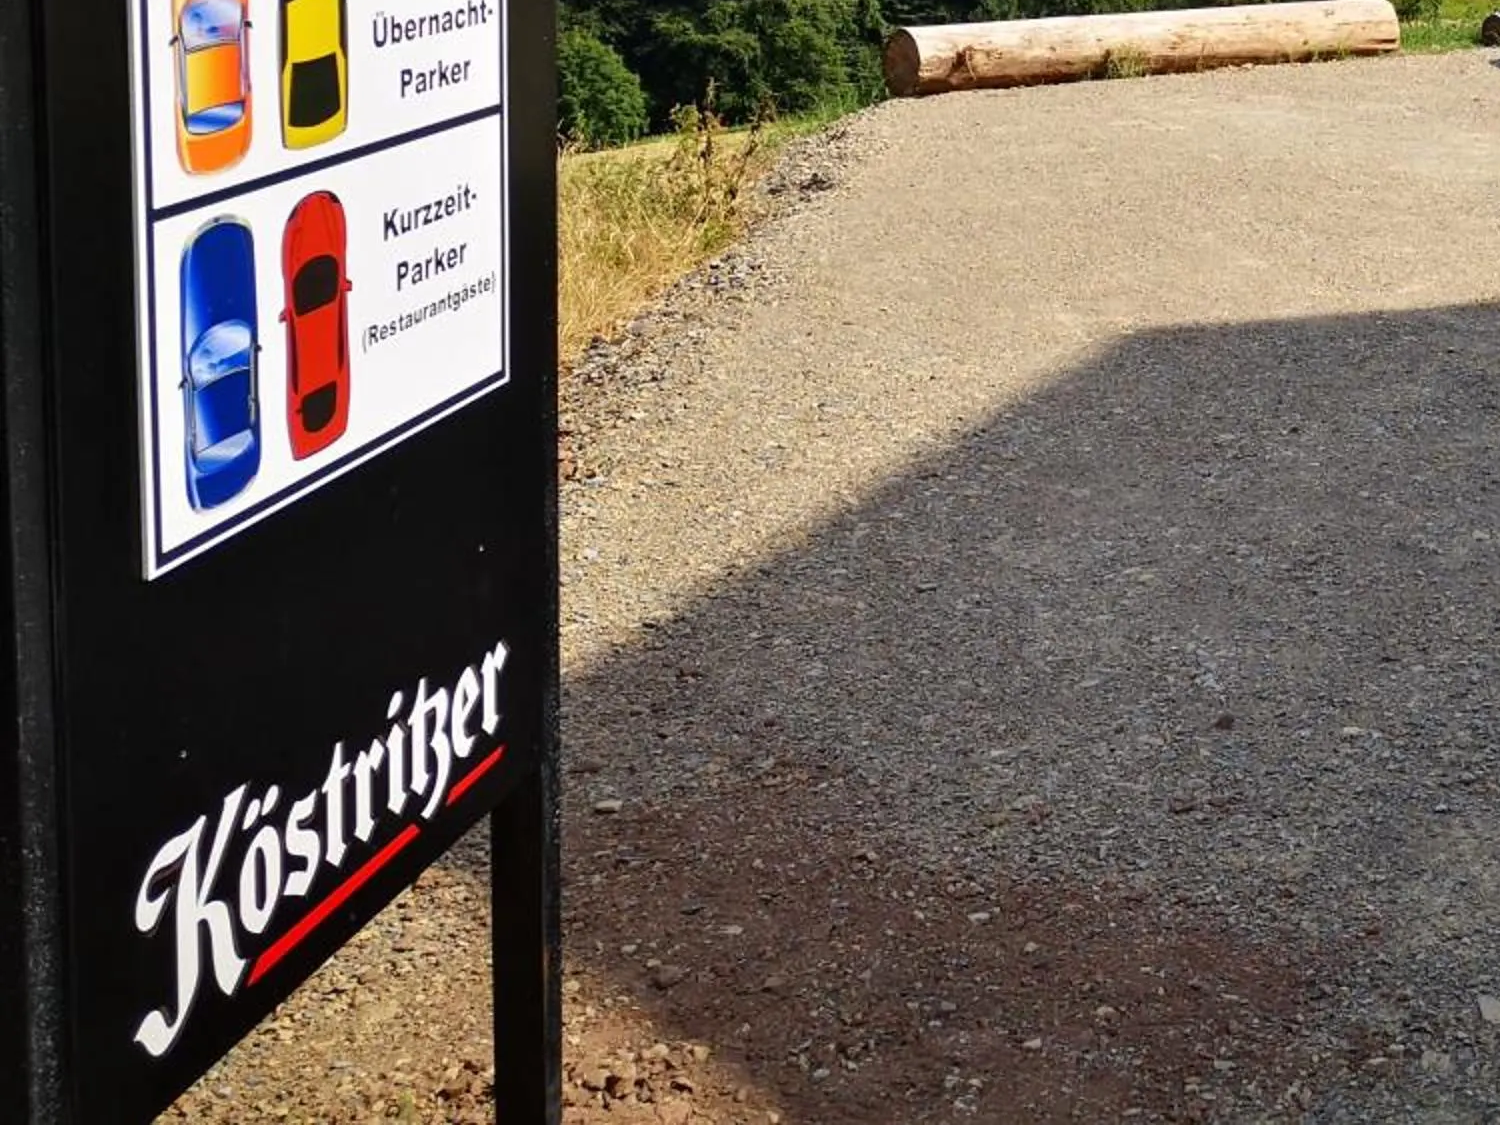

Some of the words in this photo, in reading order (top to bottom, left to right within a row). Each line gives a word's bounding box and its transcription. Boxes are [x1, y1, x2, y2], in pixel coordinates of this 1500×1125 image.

[401, 60, 472, 99] Parker
[383, 182, 477, 242] Kurzzeit-
[396, 243, 468, 292] Parker
[361, 270, 497, 354] (Restaurantgäste)
